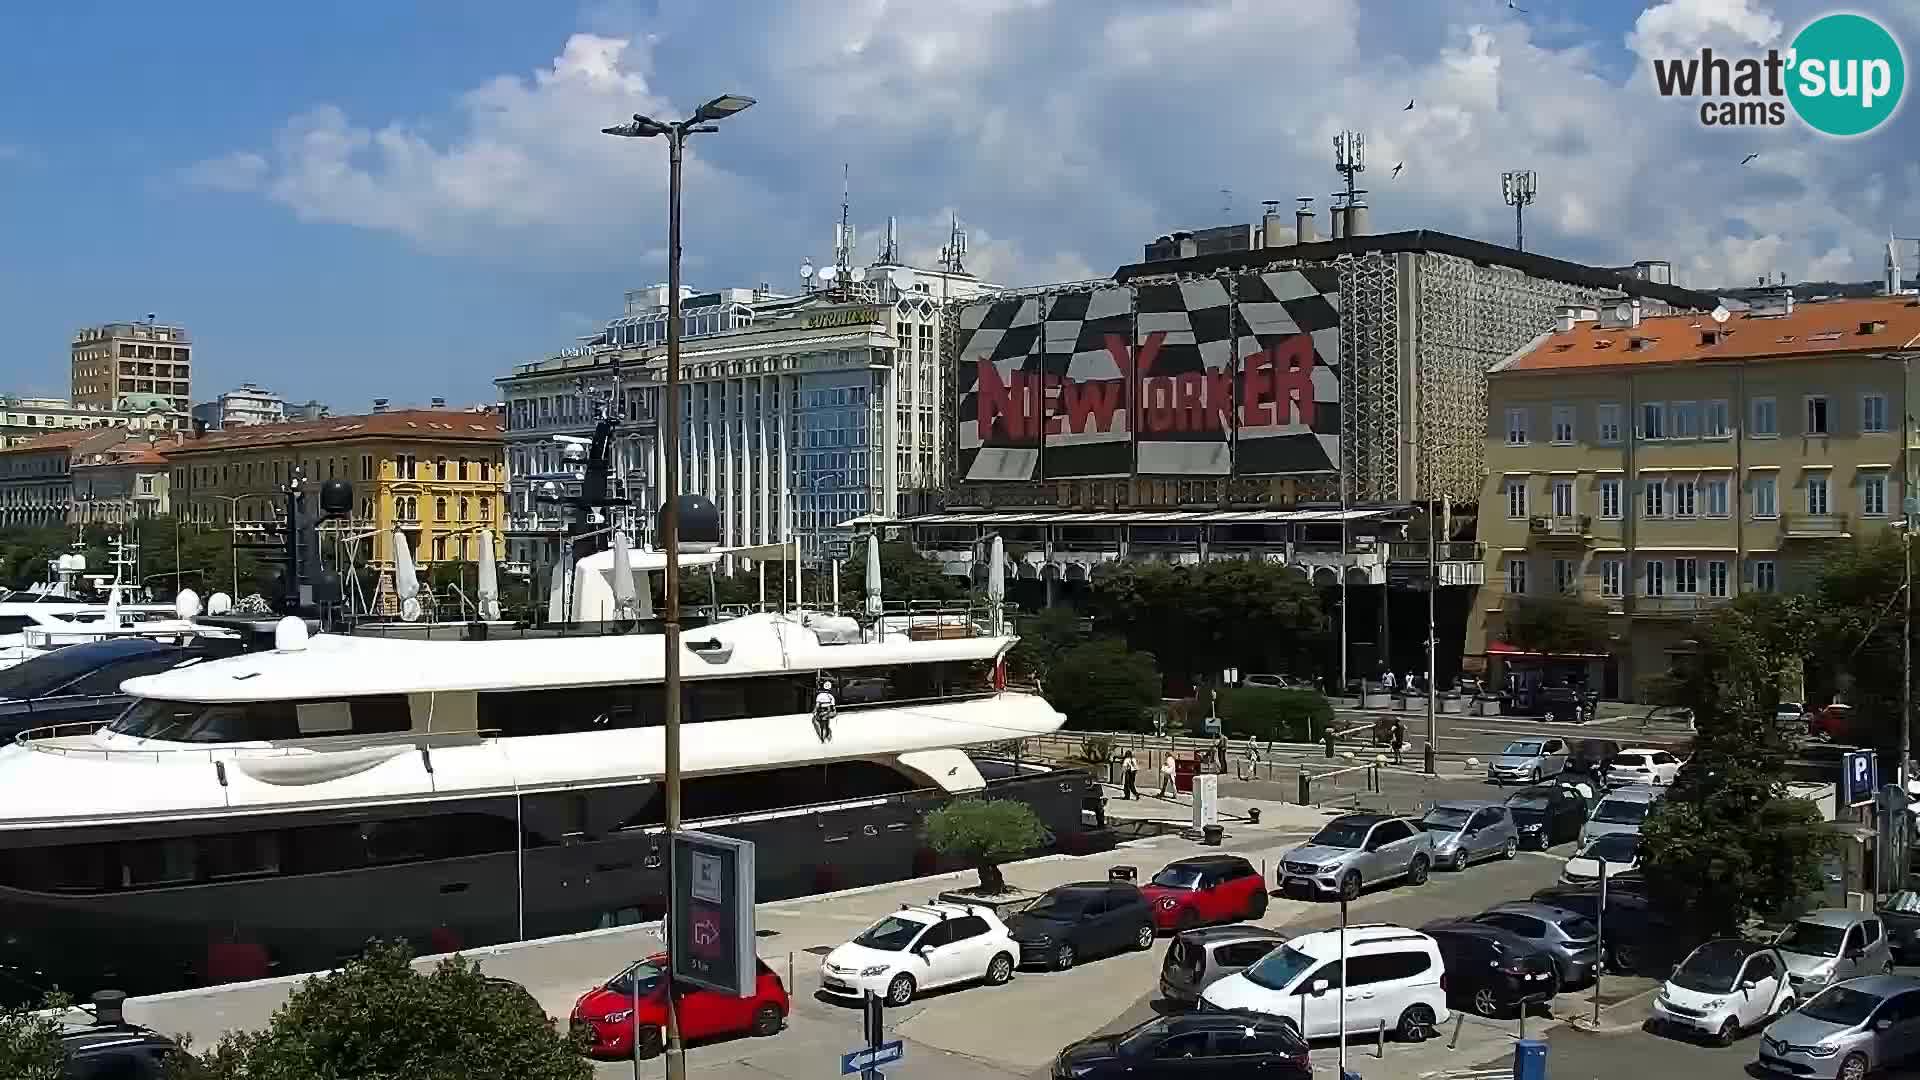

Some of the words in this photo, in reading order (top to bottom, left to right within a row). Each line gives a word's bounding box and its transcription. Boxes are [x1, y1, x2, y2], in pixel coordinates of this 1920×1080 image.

[976, 354, 1122, 441] NEW
[1103, 330, 1315, 432] YORKER
[1855, 757, 1868, 782] P
